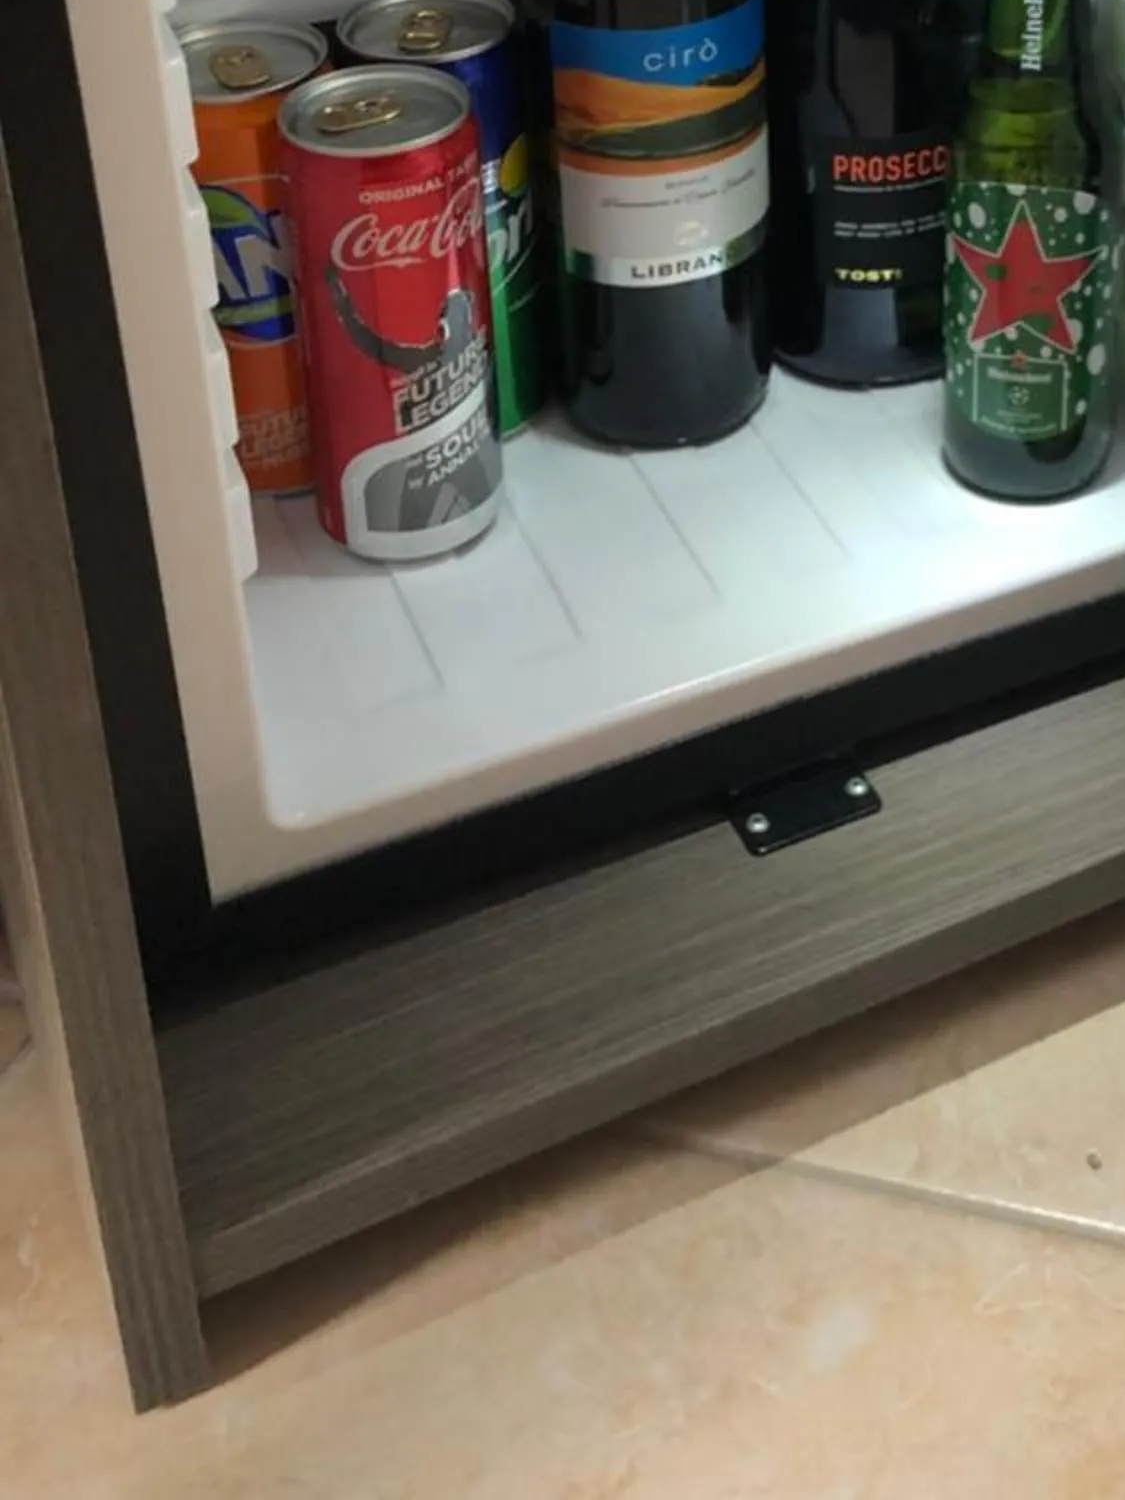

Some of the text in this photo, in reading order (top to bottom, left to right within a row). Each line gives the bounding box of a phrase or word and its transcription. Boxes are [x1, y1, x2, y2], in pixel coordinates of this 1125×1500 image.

[642, 37, 720, 73] cirò
[832, 145, 947, 183] PROSECC
[358, 176, 446, 205] ORIGINAL
